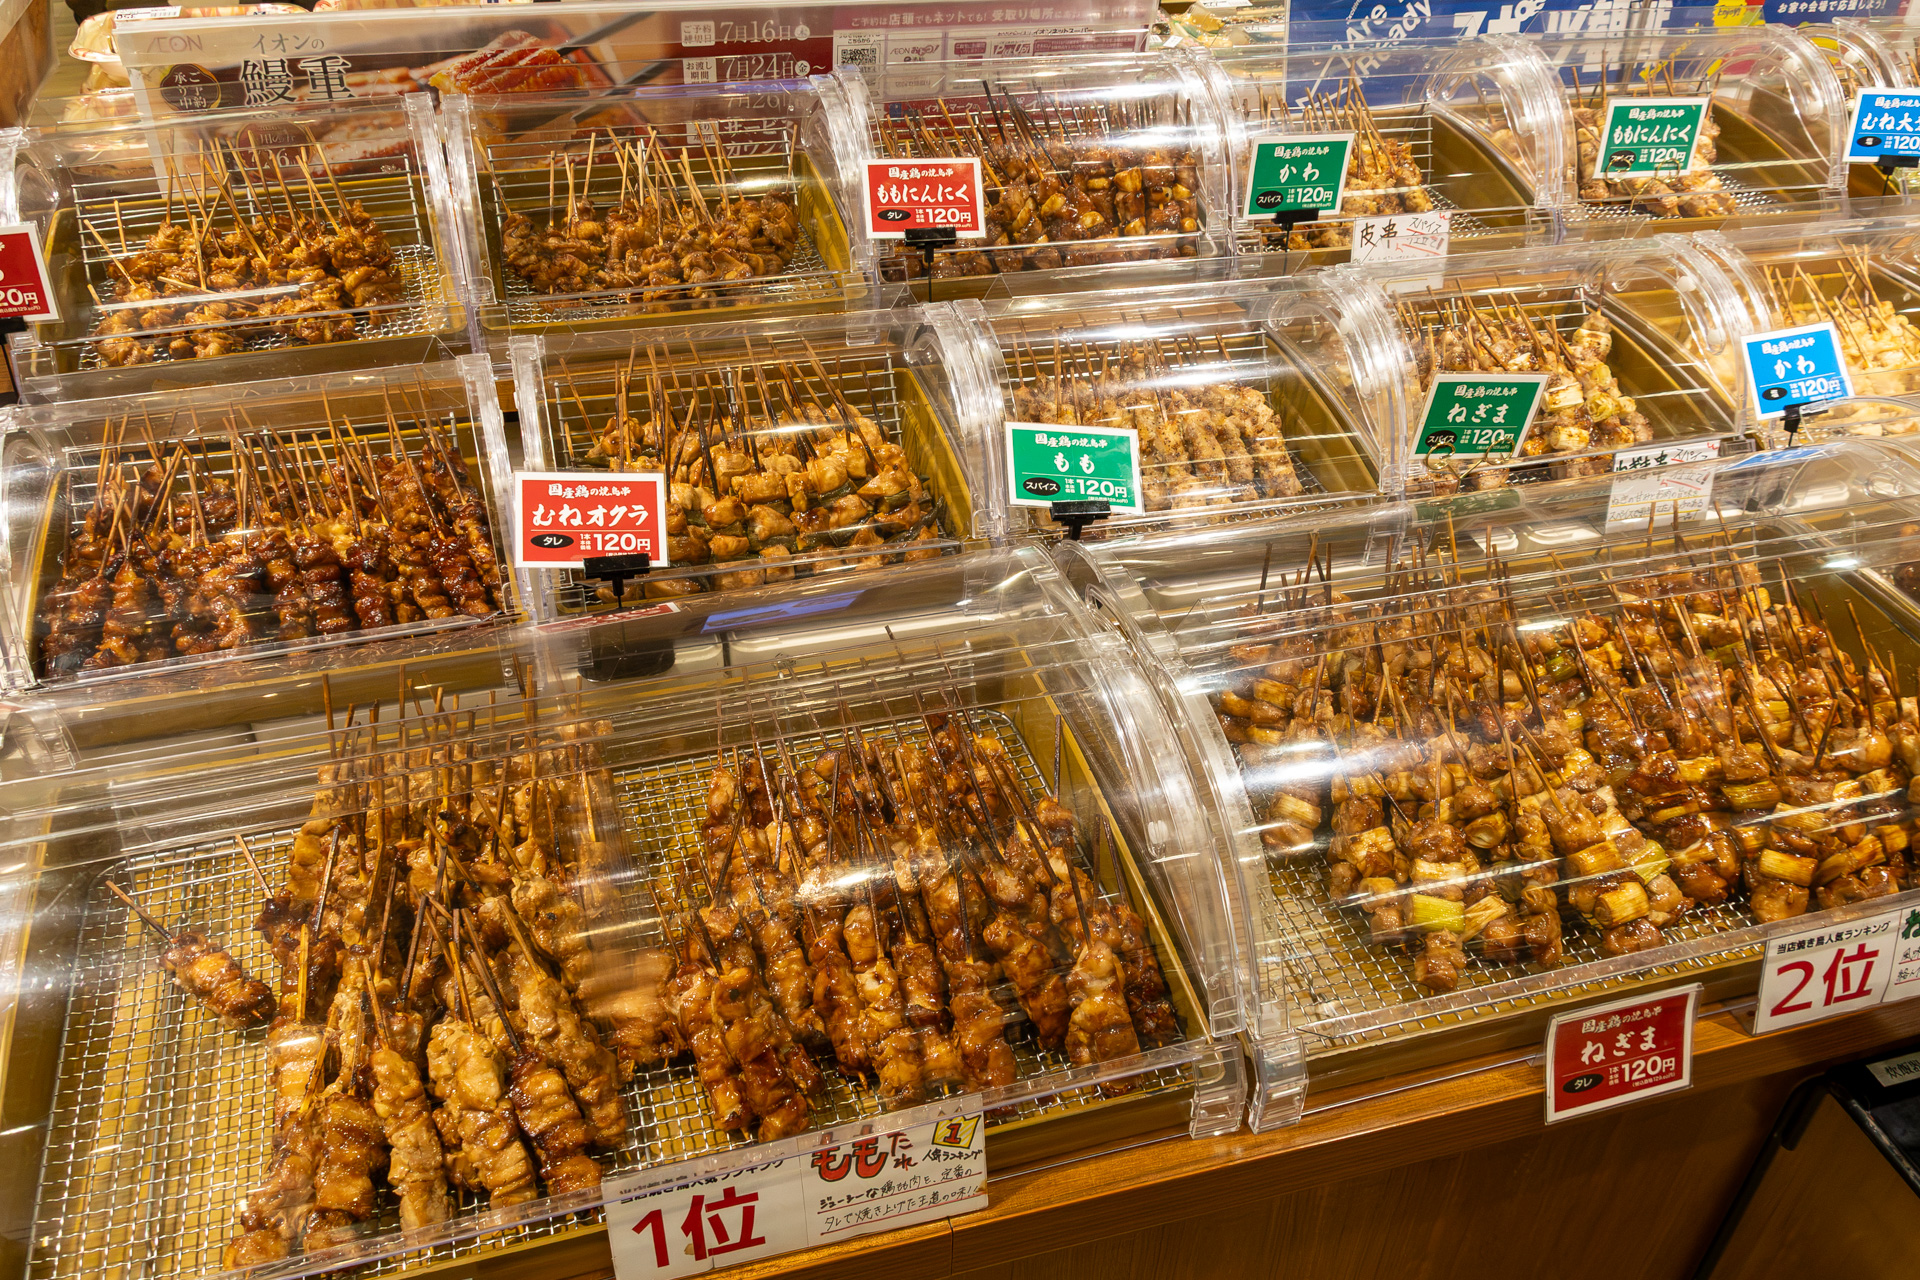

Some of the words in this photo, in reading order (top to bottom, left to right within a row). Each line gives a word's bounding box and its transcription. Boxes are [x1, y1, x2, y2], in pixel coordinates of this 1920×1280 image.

[720, 20, 791, 44] 7月16日
[252, 33, 325, 54] イオンの
[722, 55, 794, 80] 7月24日
[239, 55, 355, 106] 鰻重
[1613, 124, 1692, 145] ももにんにく
[1894, 135, 1920, 150] 120
[1648, 148, 1687, 164] 120円
[1279, 162, 1320, 184] かわ
[877, 184, 970, 204] ももにんにく
[1257, 195, 1282, 205] スパイス
[1296, 187, 1334, 203] 120円
[887, 211, 903, 220] タレ
[926, 208, 972, 223] 120円
[1360, 217, 1398, 249] 皮串
[1773, 354, 1816, 380] かわ
[1797, 377, 1841, 397] 120円
[1447, 402, 1510, 424] ねぎま
[1427, 434, 1456, 444] スパイス
[1472, 429, 1515, 445] 120円
[1053, 451, 1096, 475] もも
[548, 483, 632, 499] 国産鶏の焼鳥串
[1025, 481, 1059, 492] スパイス
[1076, 478, 1128, 498] 120円
[531, 503, 650, 527] むねオクラ
[543, 537, 564, 546] タレ
[593, 533, 651, 551] 120円
[1776, 920, 1892, 955] 当店焼き鳥人気ランキング
[1769, 943, 1880, 1018] 2位
[1580, 1026, 1657, 1066] ねぎま
[1608, 1066, 1620, 1075] 1本
[1621, 1055, 1676, 1083] 120円
[1574, 1077, 1594, 1090] タレ
[943, 1122, 963, 1144] 1
[922, 1149, 983, 1163] 人気ランキング
[631, 1185, 766, 1269] 1位
